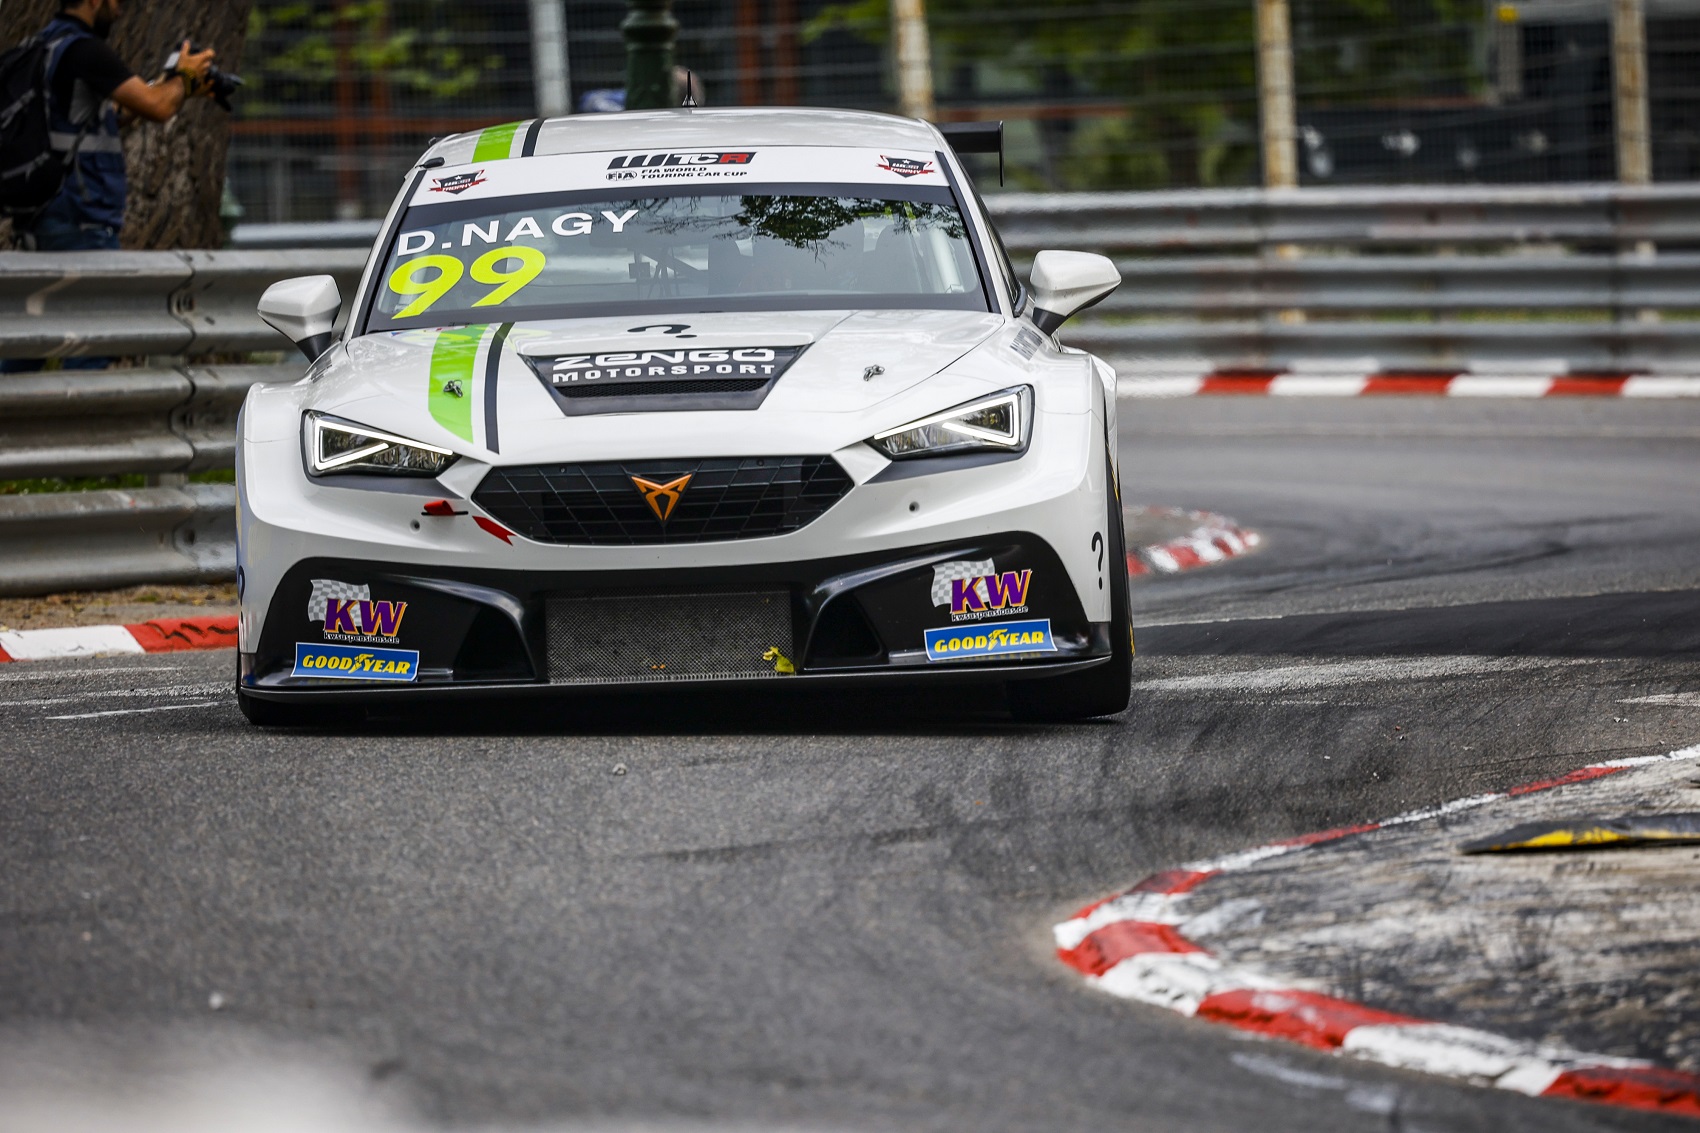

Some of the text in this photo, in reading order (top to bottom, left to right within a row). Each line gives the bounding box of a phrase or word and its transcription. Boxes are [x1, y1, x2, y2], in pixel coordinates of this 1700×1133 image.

[397, 209, 639, 256] D.NAGY
[388, 245, 546, 320] 99
[552, 364, 775, 384] MOTORSPORT
[950, 569, 1032, 614] KW
[323, 598, 408, 637] KW
[951, 606, 1029, 622] kwsuspensions.de
[323, 632, 400, 644] kwsuspensions.de
